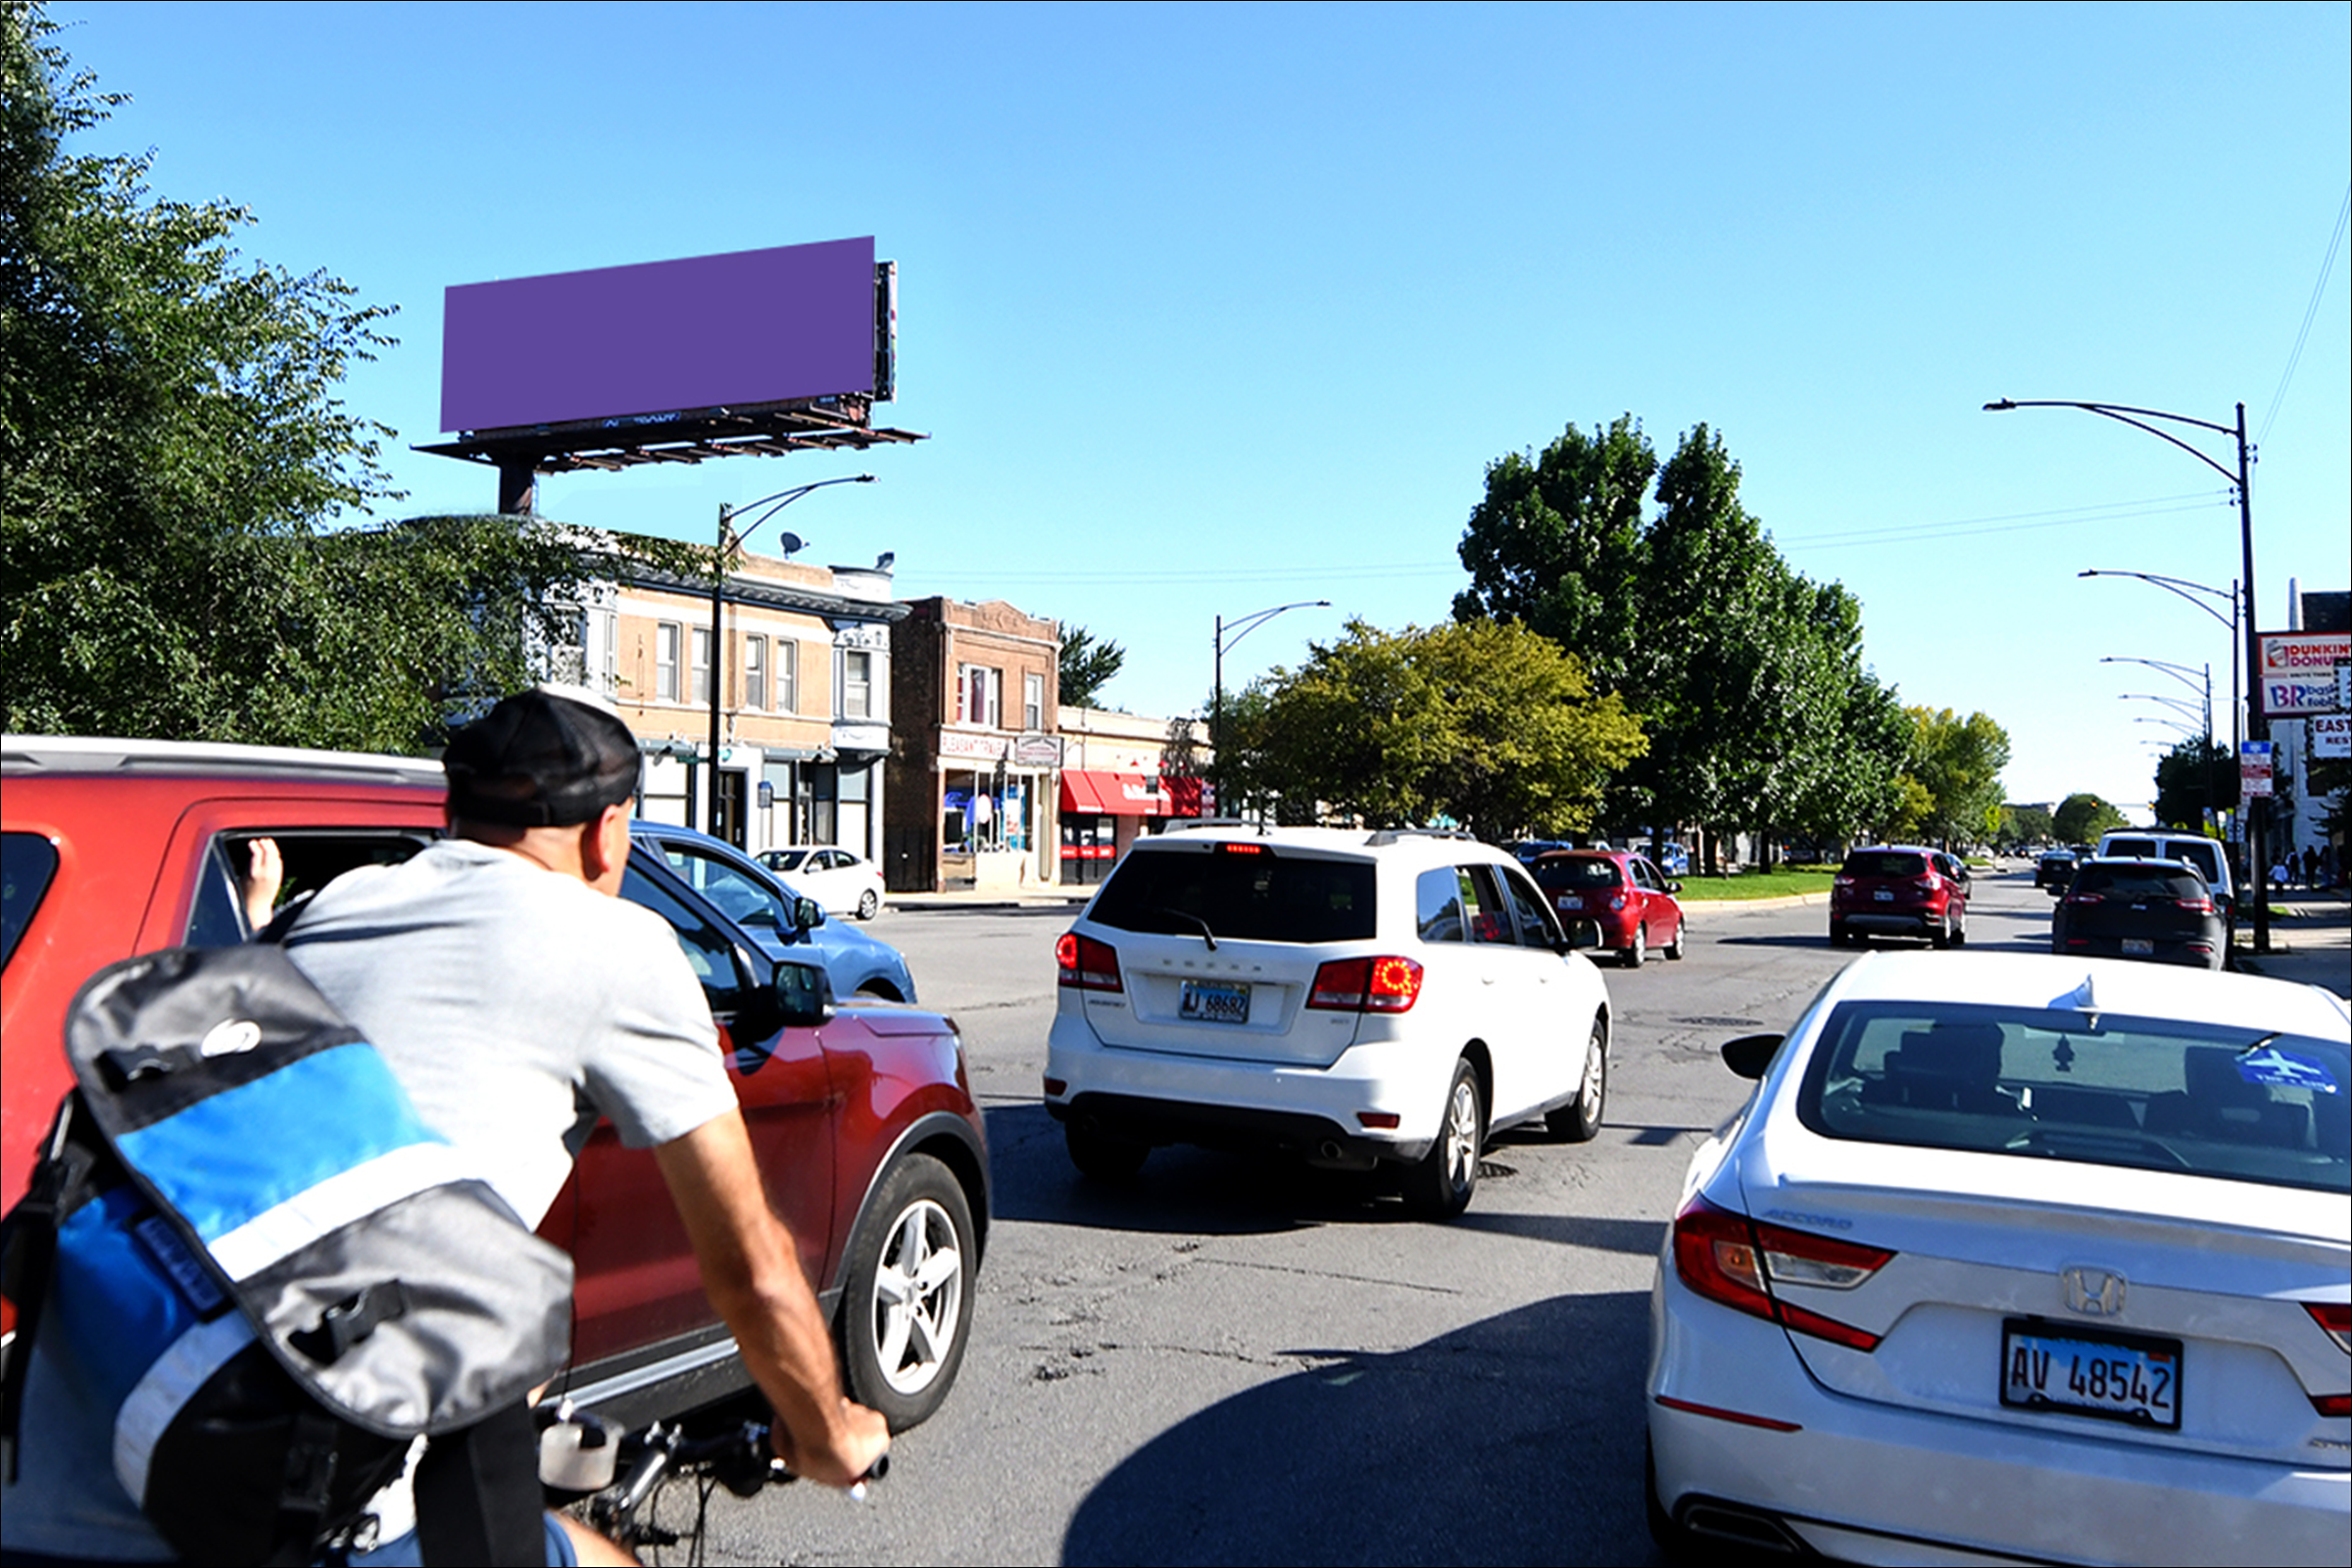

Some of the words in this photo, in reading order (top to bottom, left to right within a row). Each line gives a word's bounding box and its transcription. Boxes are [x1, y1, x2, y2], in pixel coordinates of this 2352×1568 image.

[2270, 684, 2306, 707] BR
[2011, 1347, 2050, 1391] AV
[2069, 1354, 2170, 1409] 48542
